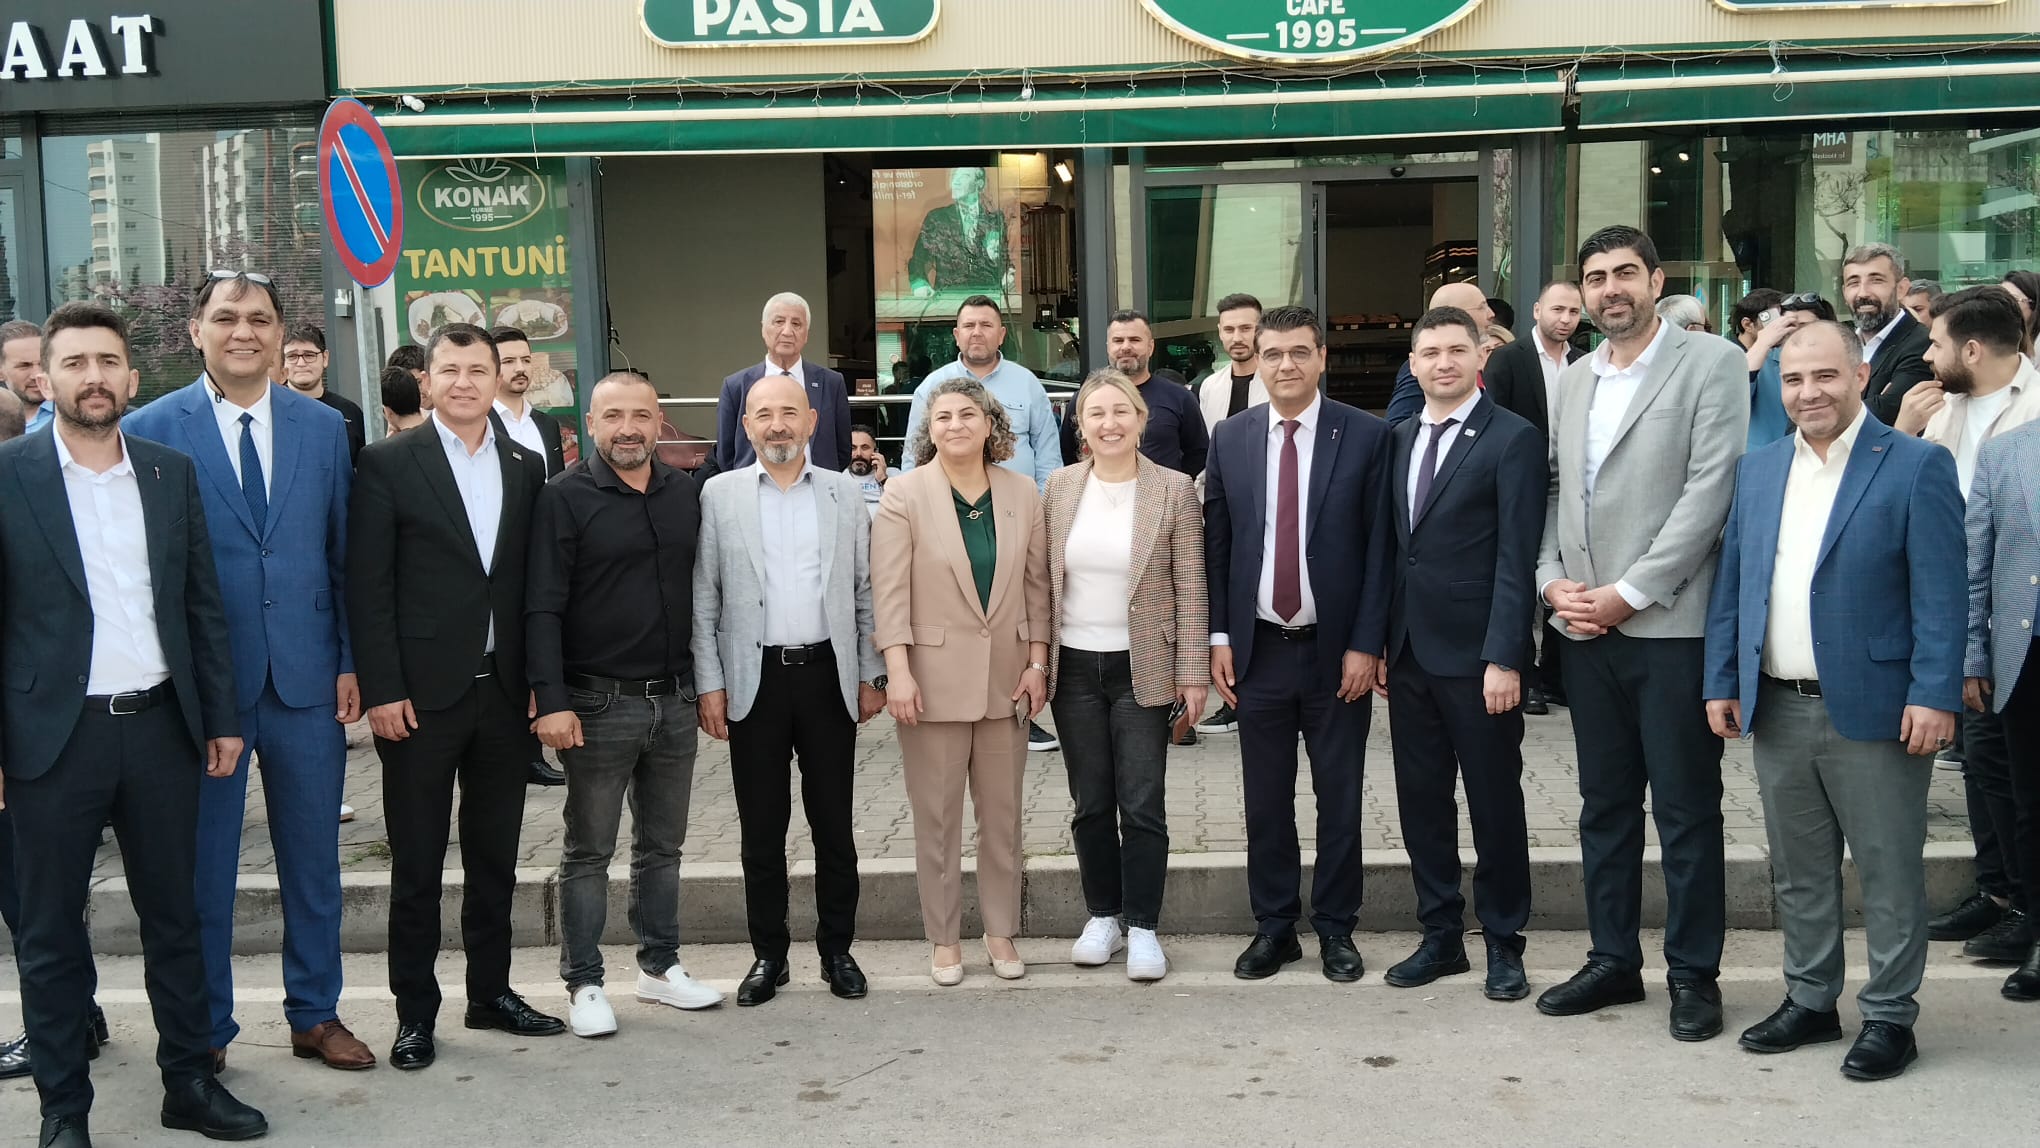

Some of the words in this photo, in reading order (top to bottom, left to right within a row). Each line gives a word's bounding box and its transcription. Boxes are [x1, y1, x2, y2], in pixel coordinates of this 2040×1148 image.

[1286, 0, 1346, 16] CAFE
[1275, 19, 1357, 49] 1995
[0, 14, 152, 79] AAT
[434, 185, 530, 208] KONAK
[470, 213, 494, 222] 1995
